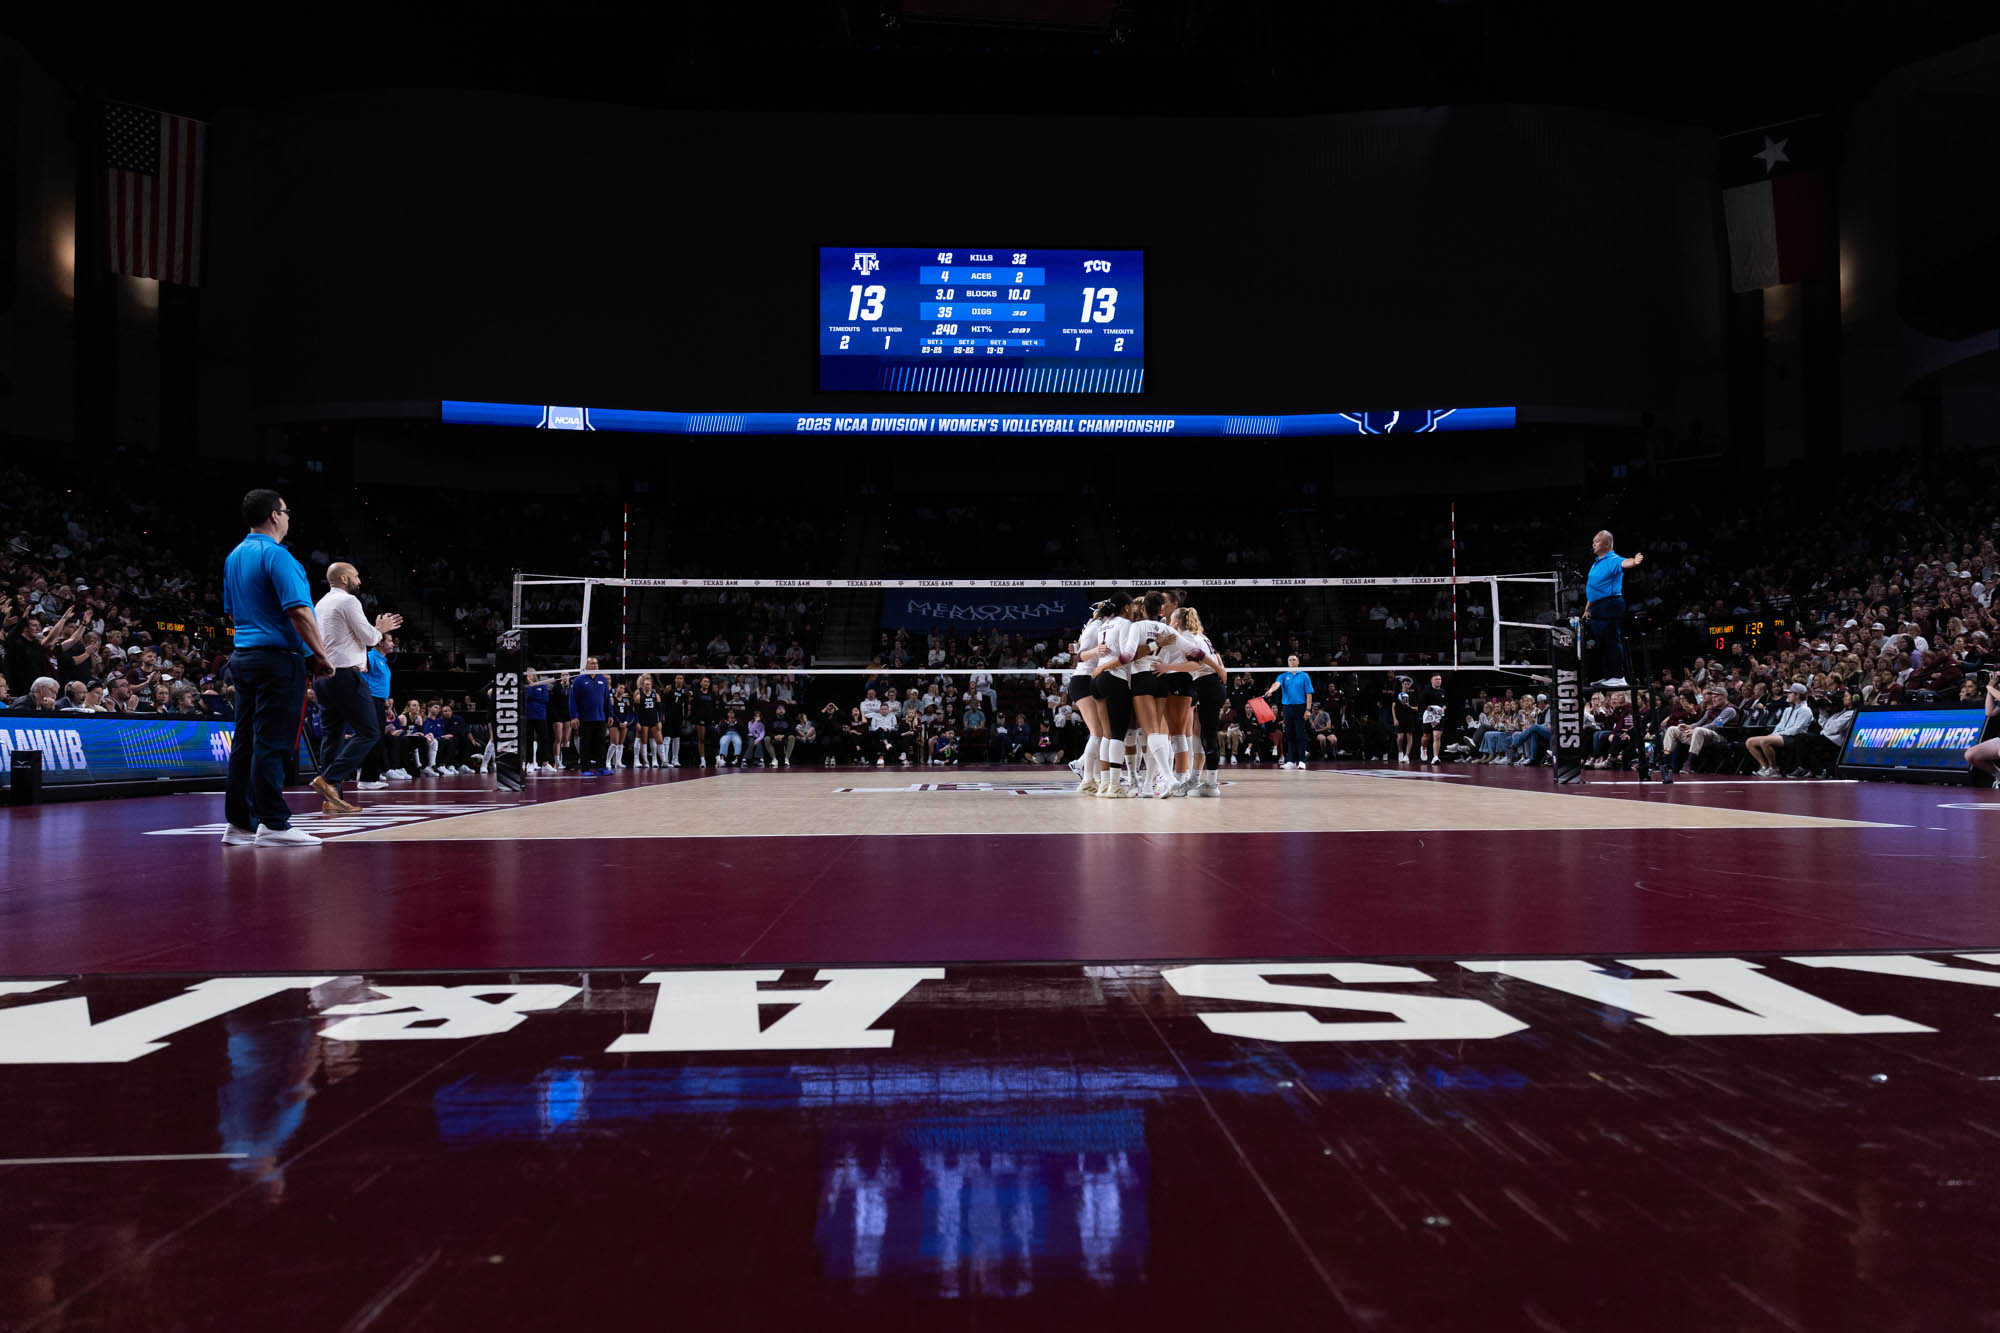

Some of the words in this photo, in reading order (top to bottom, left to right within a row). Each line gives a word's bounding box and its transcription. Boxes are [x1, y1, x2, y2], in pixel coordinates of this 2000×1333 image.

[937, 252, 953, 265] 42
[969, 254, 994, 262] KILLS
[1011, 253, 1028, 265] 32
[1083, 259, 1112, 274] TCU
[940, 270, 950, 283] 4
[970, 272, 992, 280] ACES
[1015, 271, 1024, 284] 2
[935, 288, 955, 301] 3.0
[965, 290, 998, 298] BLOCKS
[1007, 288, 1031, 301] 10.0
[848, 284, 887, 321] 13
[1080, 287, 1119, 324] 13
[937, 306, 953, 319] 35
[971, 307, 993, 316] DIGS
[931, 323, 959, 336] .240
[971, 325, 993, 333] HIT%
[839, 335, 851, 350] 2
[884, 335, 891, 350] 1
[1074, 337, 1081, 352] 1
[1113, 337, 1125, 352] 2
[554, 416, 580, 425] NCAA
[796, 418, 832, 432] 2025
[834, 418, 867, 432] NCAA
[871, 418, 927, 432] DIVISION
[929, 418, 935, 432] I
[938, 418, 999, 432] WOMEN'S
[1002, 418, 1074, 432] VOLLEYBALL
[1078, 418, 1175, 432] CHAMPIONSHIP
[1716, 637, 1725, 650] 13
[496, 672, 518, 755] AGGIES
[1557, 669, 1581, 748] AGGIES
[1852, 727, 1920, 749] CHAMPIONS
[1917, 727, 1945, 749] WIN
[1941, 727, 1978, 749] HERE
